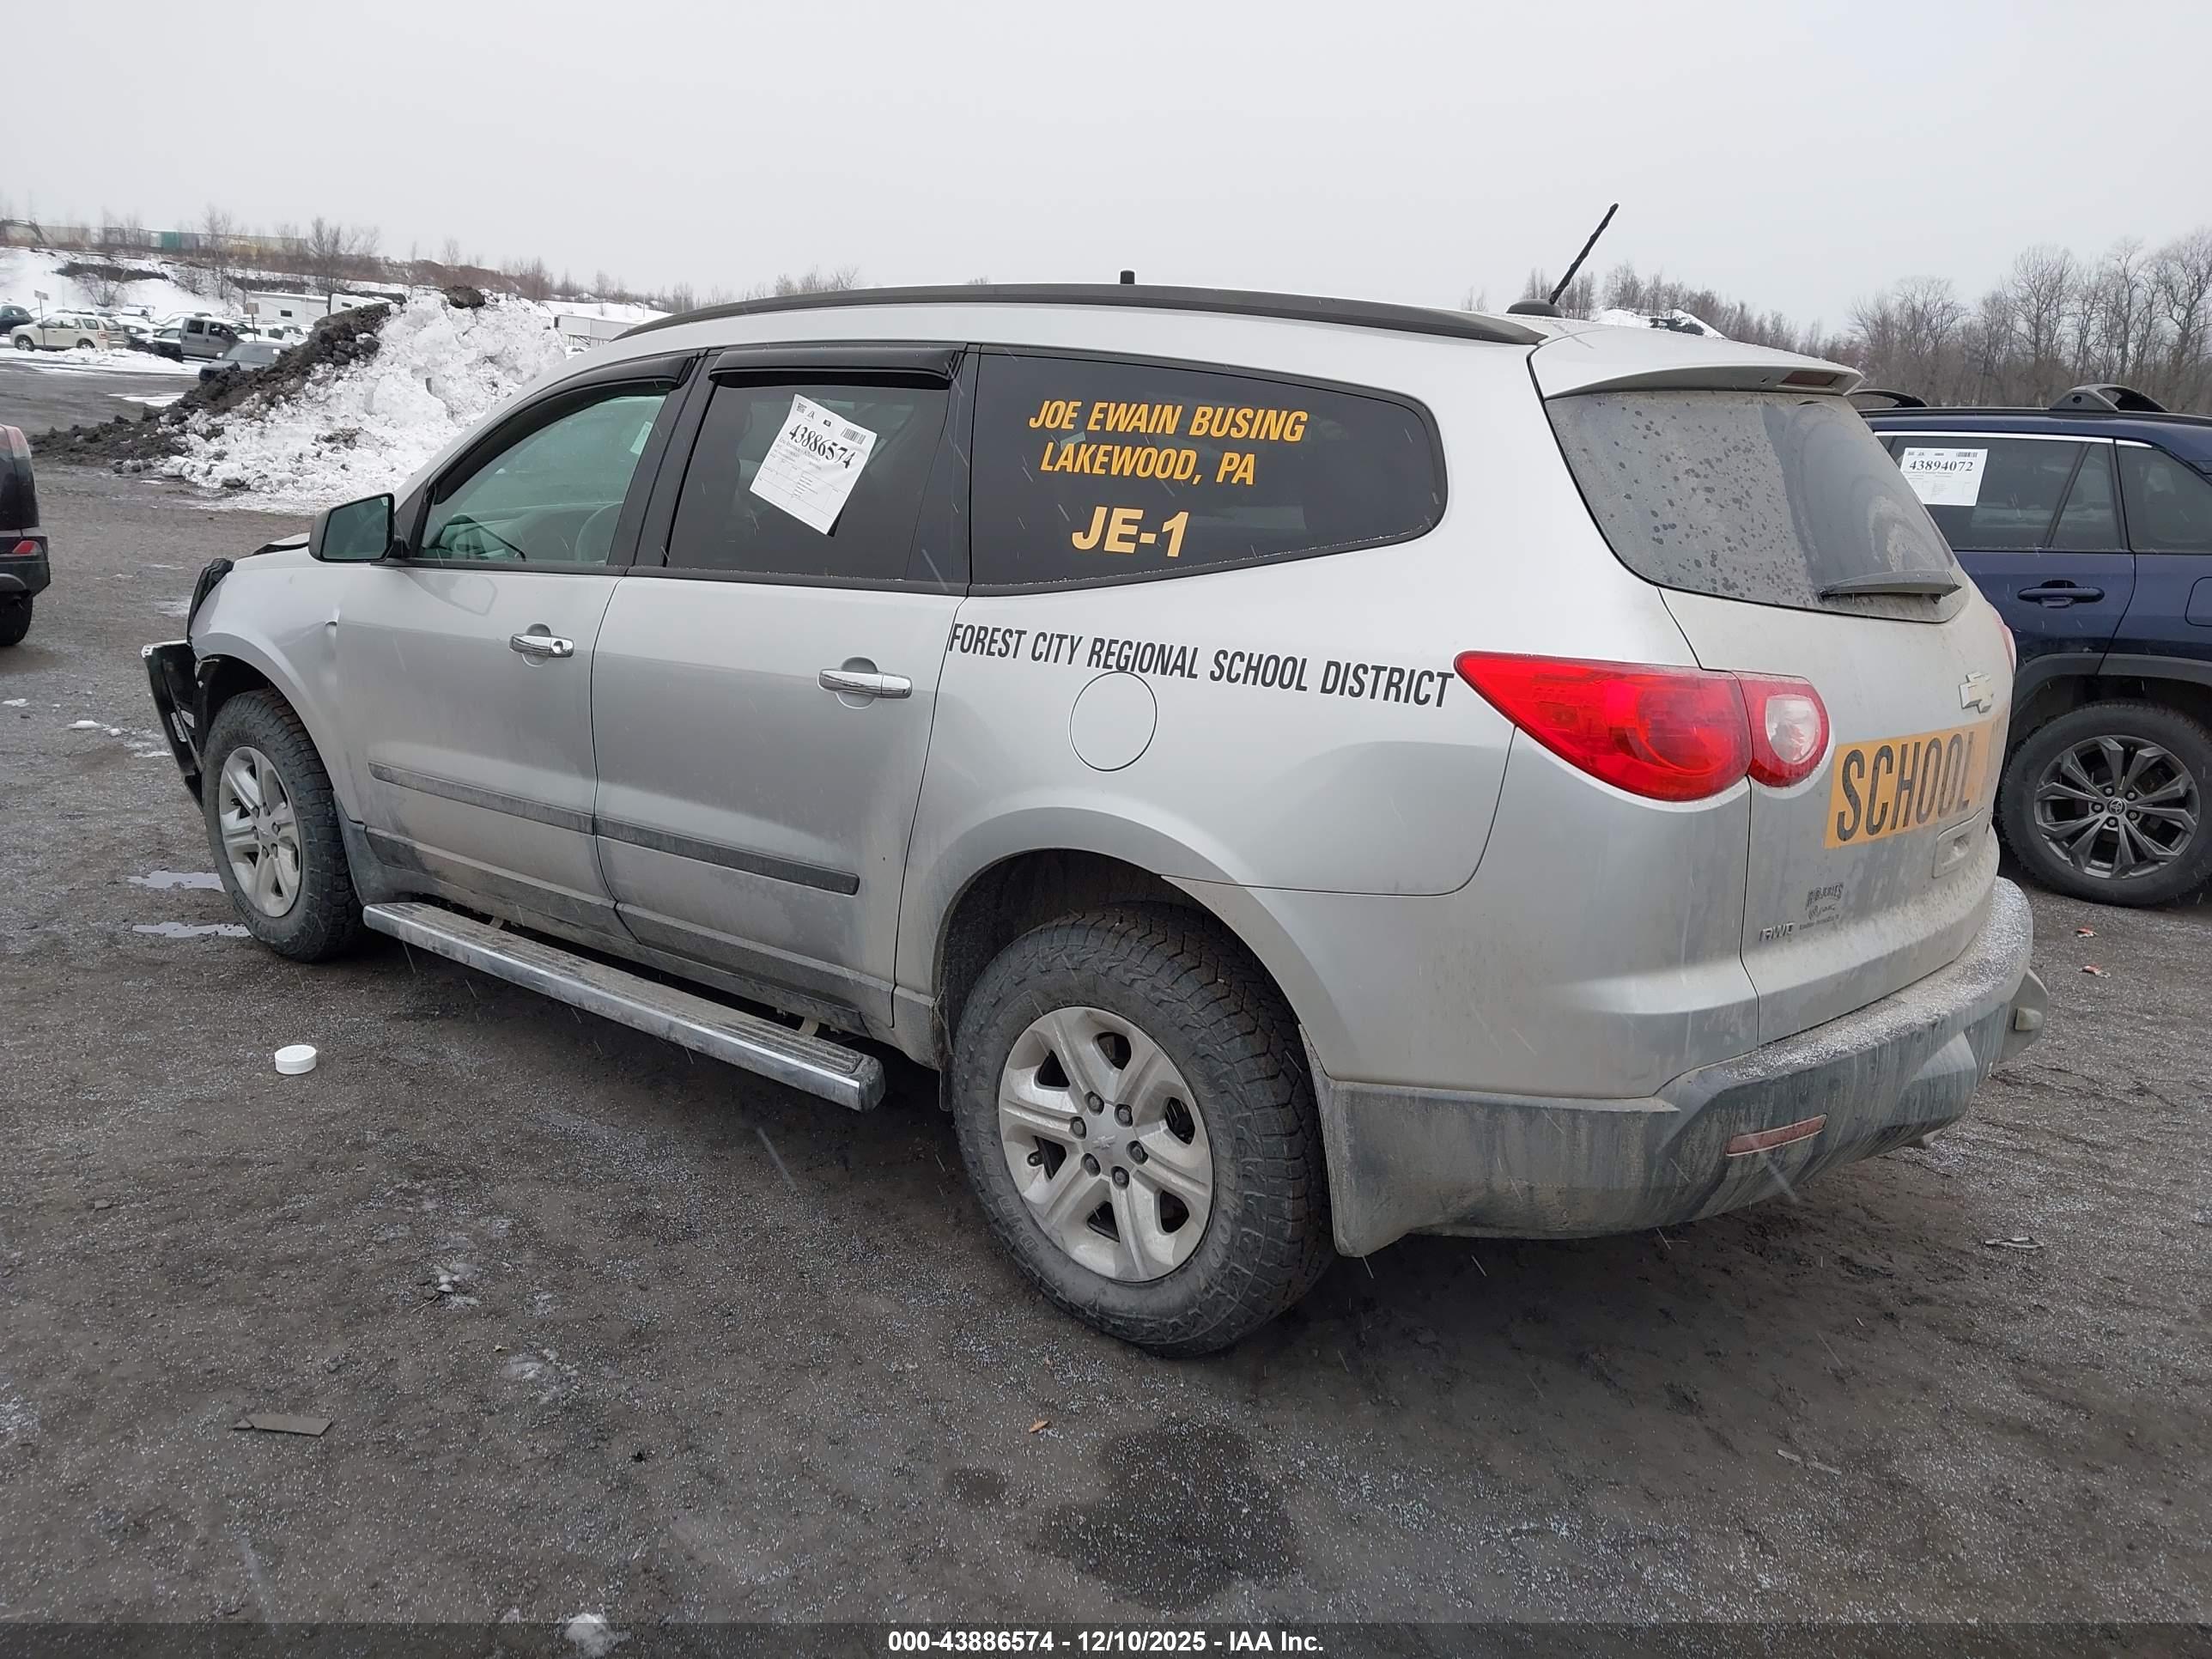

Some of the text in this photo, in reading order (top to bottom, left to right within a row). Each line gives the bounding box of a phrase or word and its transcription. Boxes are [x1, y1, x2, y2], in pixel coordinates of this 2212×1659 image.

[1029, 400, 1310, 442] JOE EWAIN BUSING
[787, 422, 857, 470] 43886574
[1039, 442, 1256, 486] LAKEWOOD, PA
[1909, 459, 1974, 472] 43894072
[1071, 507, 1190, 558] JE-1
[946, 623, 1455, 709] FOREST CITY REGIONAL SCHOOL DISTRICT
[1836, 731, 1976, 842] SCHOOL
